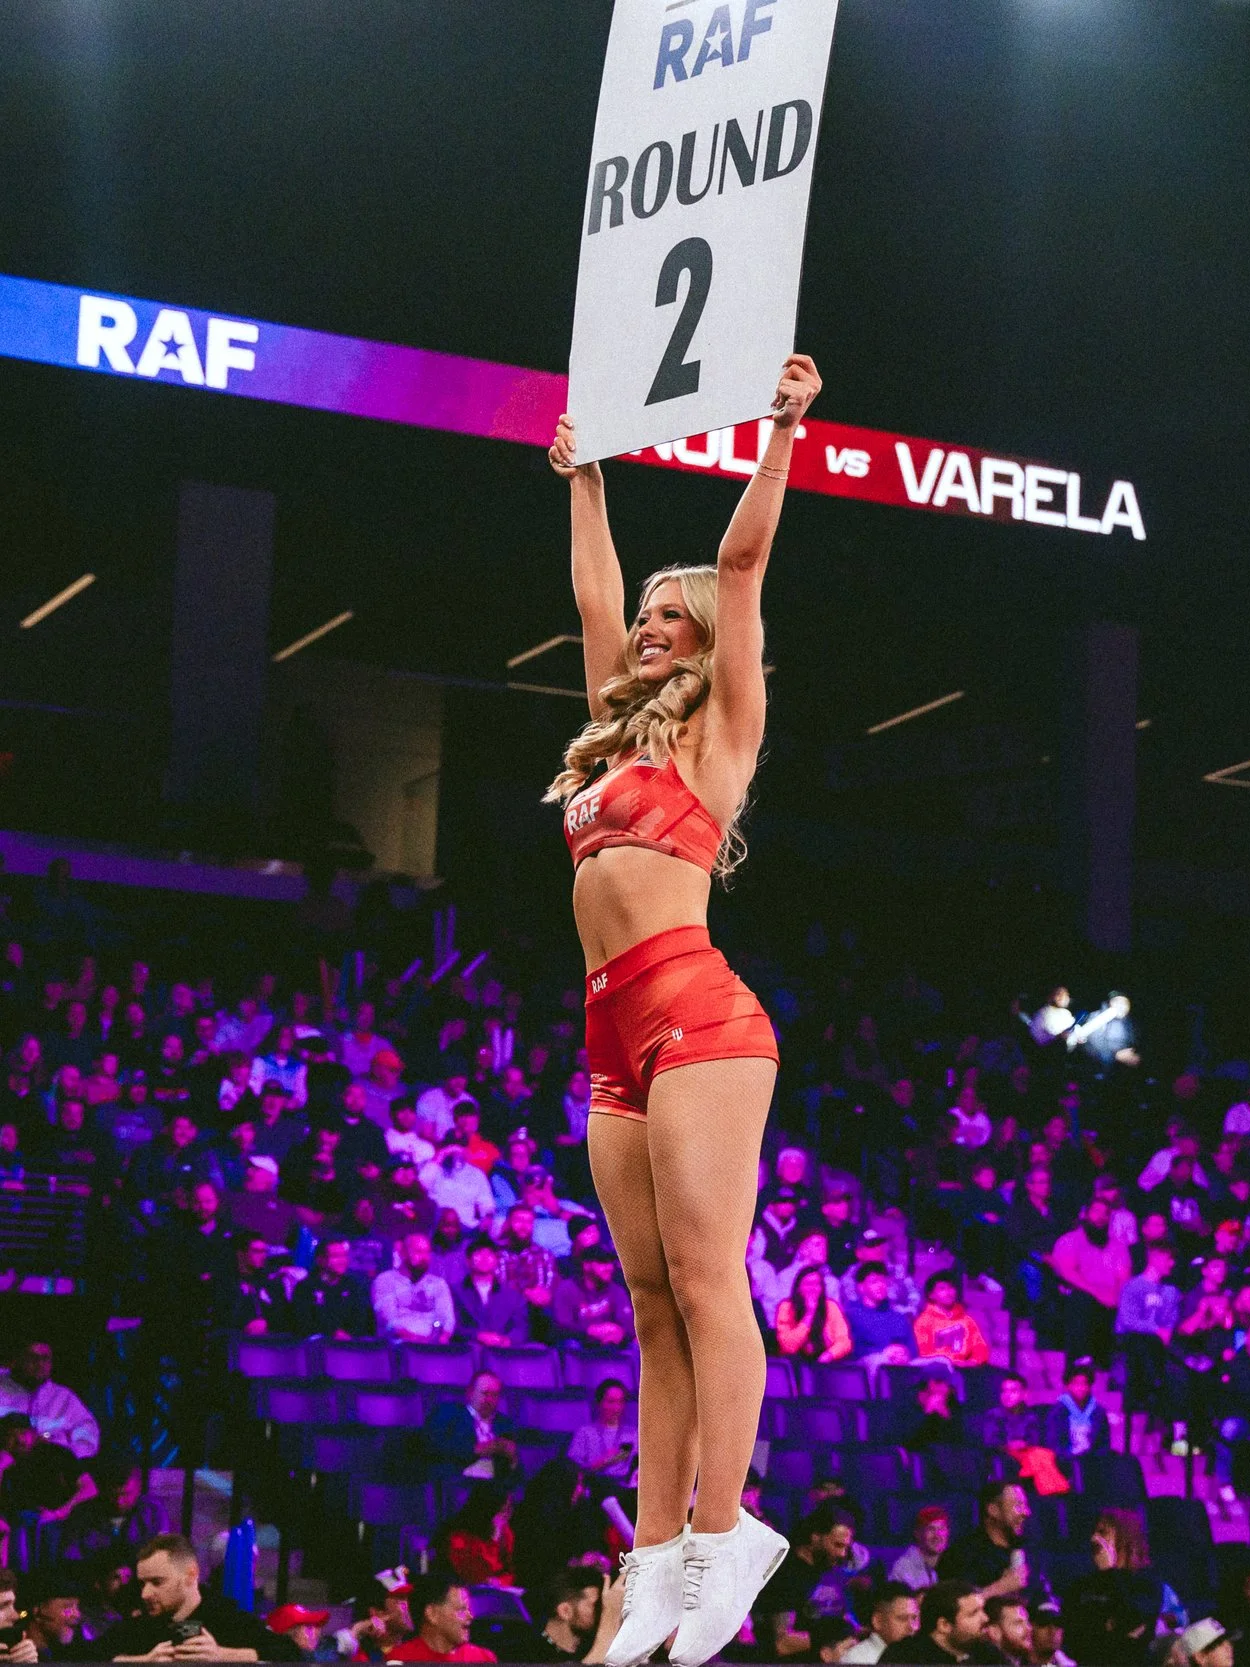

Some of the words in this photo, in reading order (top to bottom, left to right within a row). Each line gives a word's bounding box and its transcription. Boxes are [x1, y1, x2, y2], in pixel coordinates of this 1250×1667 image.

[653, 0, 778, 90] RAF
[587, 99, 813, 235] ROUND
[76, 294, 259, 389] RAF
[644, 236, 713, 406] 2
[895, 441, 1147, 541] VARELA
[567, 795, 600, 835] RAF
[591, 972, 609, 994] RAF
